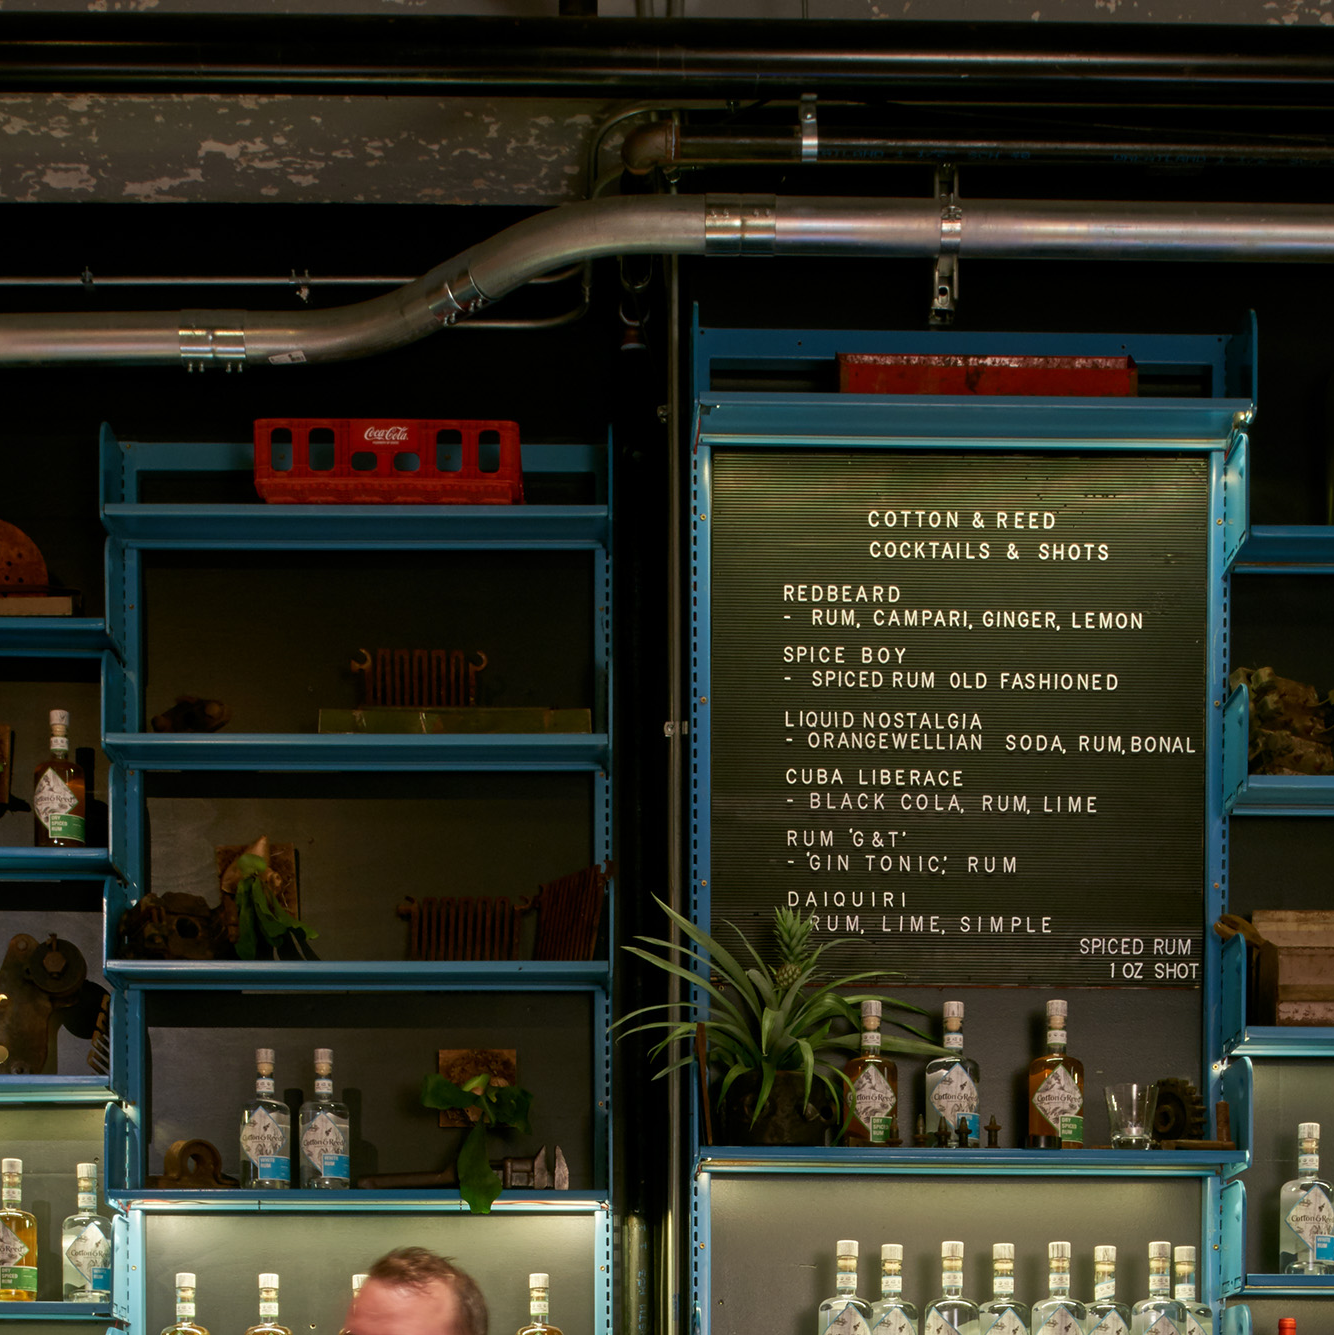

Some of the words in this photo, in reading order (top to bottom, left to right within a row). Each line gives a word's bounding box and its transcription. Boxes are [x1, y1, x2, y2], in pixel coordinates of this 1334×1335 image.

[363, 426, 409, 440] Coca-Cola
[867, 510, 959, 529] COTTON
[972, 511, 985, 529] &
[996, 511, 1056, 530] REED
[869, 541, 990, 560] COCKTAILS
[1006, 542, 1020, 560] &
[1038, 542, 1109, 561] SHOTS
[783, 584, 901, 603] REDBEARD
[812, 608, 861, 629] RUM,
[873, 609, 973, 630] CAMPARI,
[982, 610, 1061, 632] GINGER,
[1071, 611, 1143, 630] LEMON
[783, 646, 845, 664] SPICE
[861, 646, 906, 664] BOY
[812, 670, 884, 688] SPICED
[892, 671, 935, 689] RUM
[949, 672, 988, 689] OLD
[1000, 672, 1118, 691] FASHIONED
[785, 710, 855, 728] LIQUID
[863, 711, 982, 730] NOSTALGIA
[807, 732, 982, 751] ORANGEWELLIAN
[1005, 734, 1067, 755] SODA,
[1079, 735, 1126, 755] RUM,
[1130, 735, 1196, 754] BONAL
[785, 768, 844, 785] CUBA
[859, 769, 963, 787] LIBERACE
[810, 792, 885, 810] BLACK
[900, 793, 965, 814] COLA,
[982, 794, 1031, 815] RUM,
[1043, 795, 1097, 813] LIME
[787, 830, 833, 847] RUM
[968, 856, 1016, 873] RUM
[788, 891, 906, 908] DAIQUIRI
[809, 915, 865, 935] RUM,
[882, 915, 946, 935] LIME,
[960, 916, 1052, 933] SIMPLE
[1079, 937, 1144, 955] SPICED
[1153, 938, 1191, 955] RUM
[1110, 962, 1115, 979] 1
[1122, 962, 1144, 979] OZ
[1154, 962, 1200, 979] SHOT
